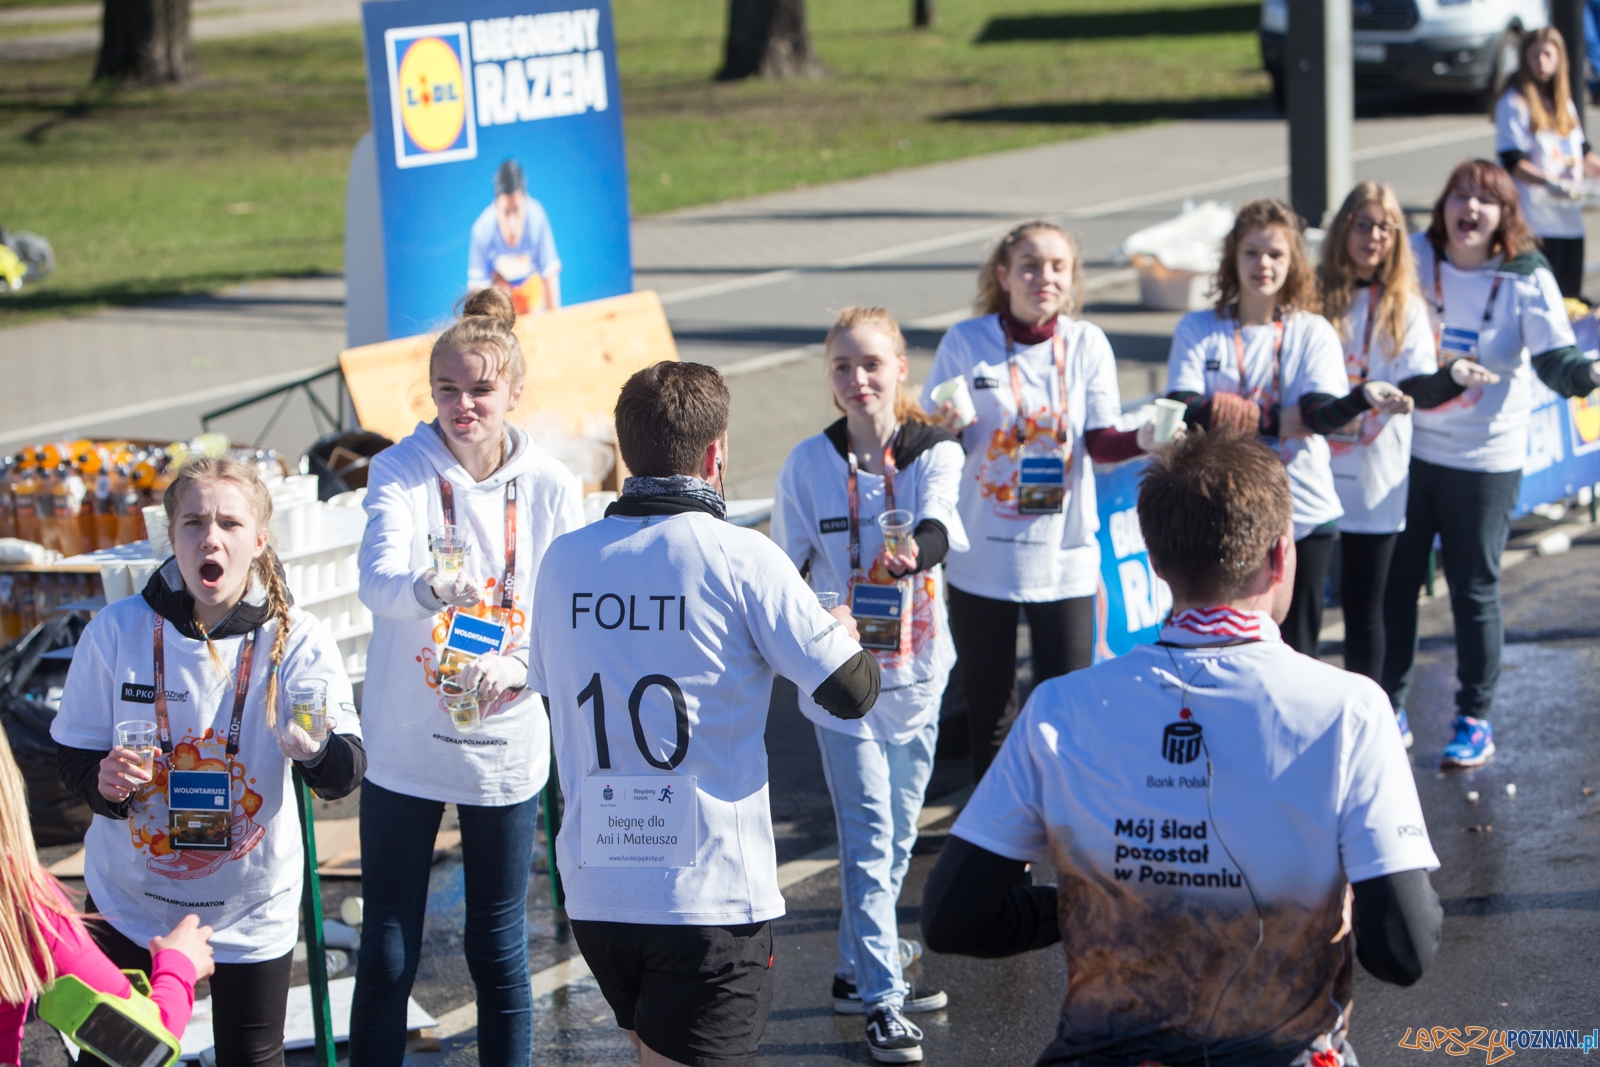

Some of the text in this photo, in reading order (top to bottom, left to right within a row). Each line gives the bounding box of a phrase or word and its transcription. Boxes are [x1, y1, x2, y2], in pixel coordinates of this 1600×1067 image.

[474, 49, 608, 127] RAZEM
[572, 592, 686, 631] FOLTI
[453, 627, 501, 648] WOLONTARIUSZ
[124, 688, 155, 699] 10. PKO
[576, 672, 690, 771] 10
[173, 787, 227, 795] WOLONTARIUSZ
[1146, 775, 1175, 789] Bank
[608, 815, 665, 831] biegnę dla
[1114, 818, 1207, 844] Mój ślad
[596, 833, 678, 845] Ani i Mateusza
[1115, 843, 1209, 864] pozostał
[1113, 865, 1242, 888] w Poznaniu
